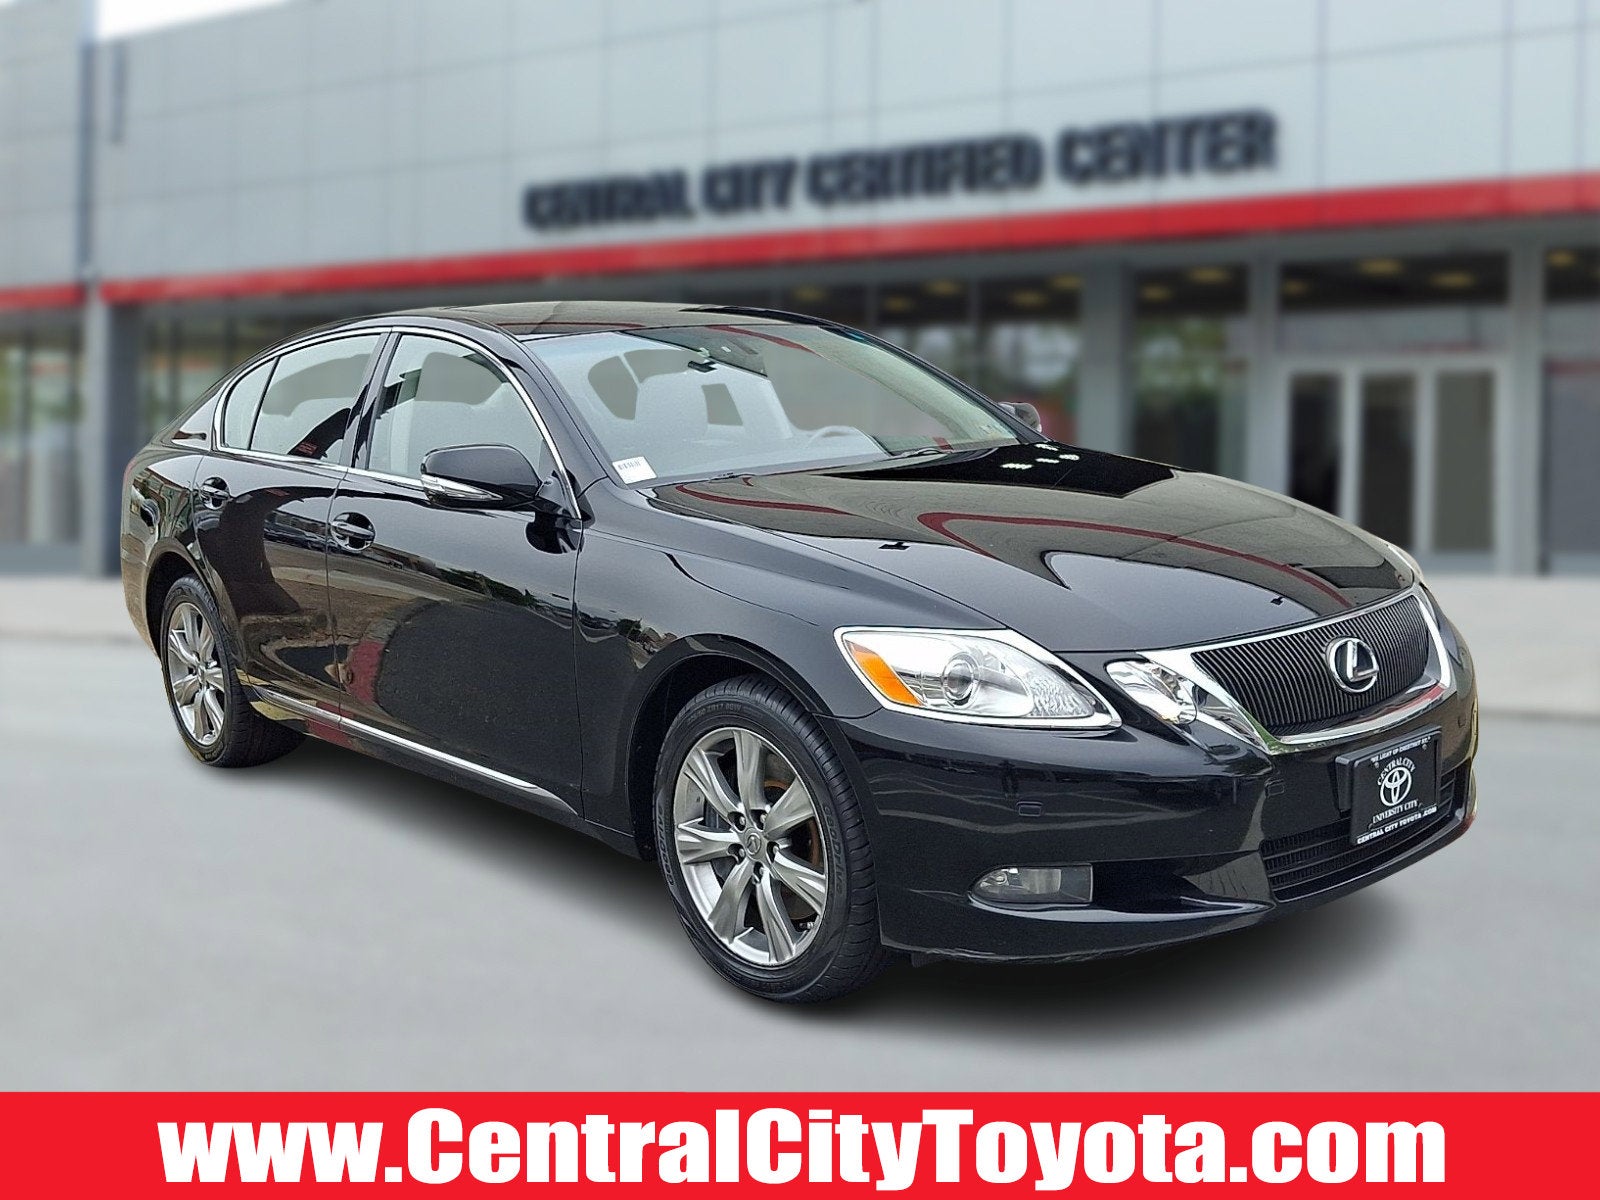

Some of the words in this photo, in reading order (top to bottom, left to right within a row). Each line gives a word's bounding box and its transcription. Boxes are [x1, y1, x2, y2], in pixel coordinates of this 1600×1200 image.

[522, 167, 695, 233] CENTRAL
[700, 154, 798, 216] CITY
[802, 131, 1047, 208] CERTIFIED
[1055, 109, 1279, 186] CENTER
[1377, 756, 1402, 786] CENTRAL
[1402, 756, 1416, 772] CITY
[1372, 803, 1403, 824] UNIVERSITY
[1404, 798, 1419, 811] CITY
[1356, 828, 1385, 845] CENTRAL
[1384, 821, 1399, 834] CITY
[1399, 812, 1422, 827] TOYOTA
